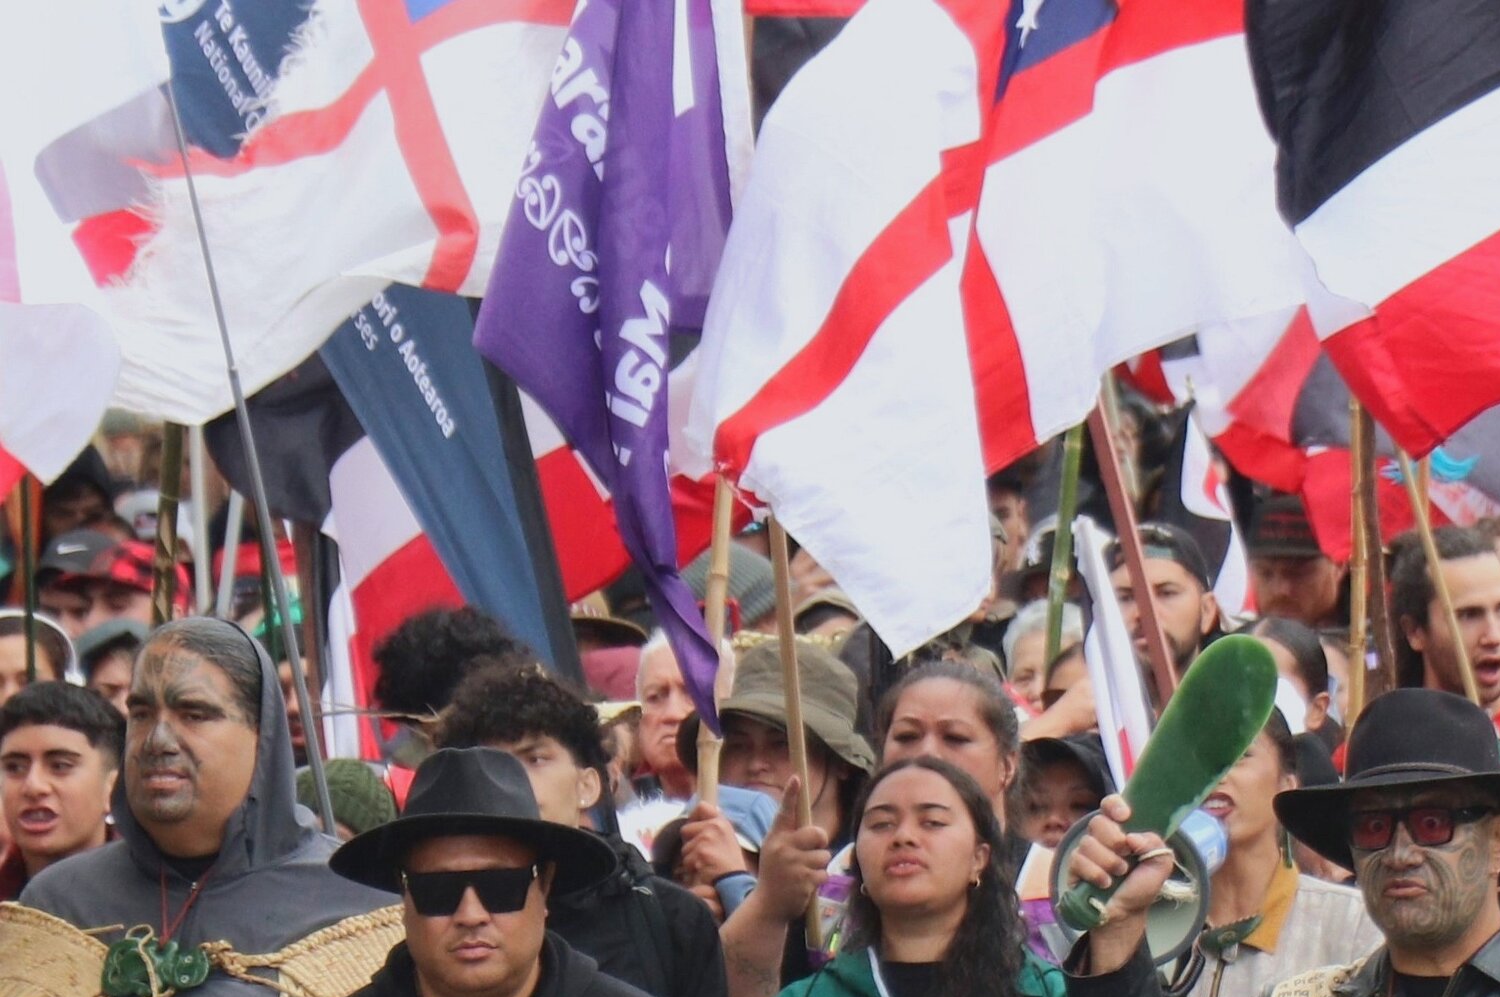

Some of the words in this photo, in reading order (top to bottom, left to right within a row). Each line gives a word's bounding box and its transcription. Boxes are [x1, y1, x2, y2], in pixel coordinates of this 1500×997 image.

[214, 0, 233, 33] Te
[194, 20, 251, 117] National
[351, 309, 379, 351] ses
[389, 323, 403, 344] o
[397, 339, 455, 440] Aotearoa
